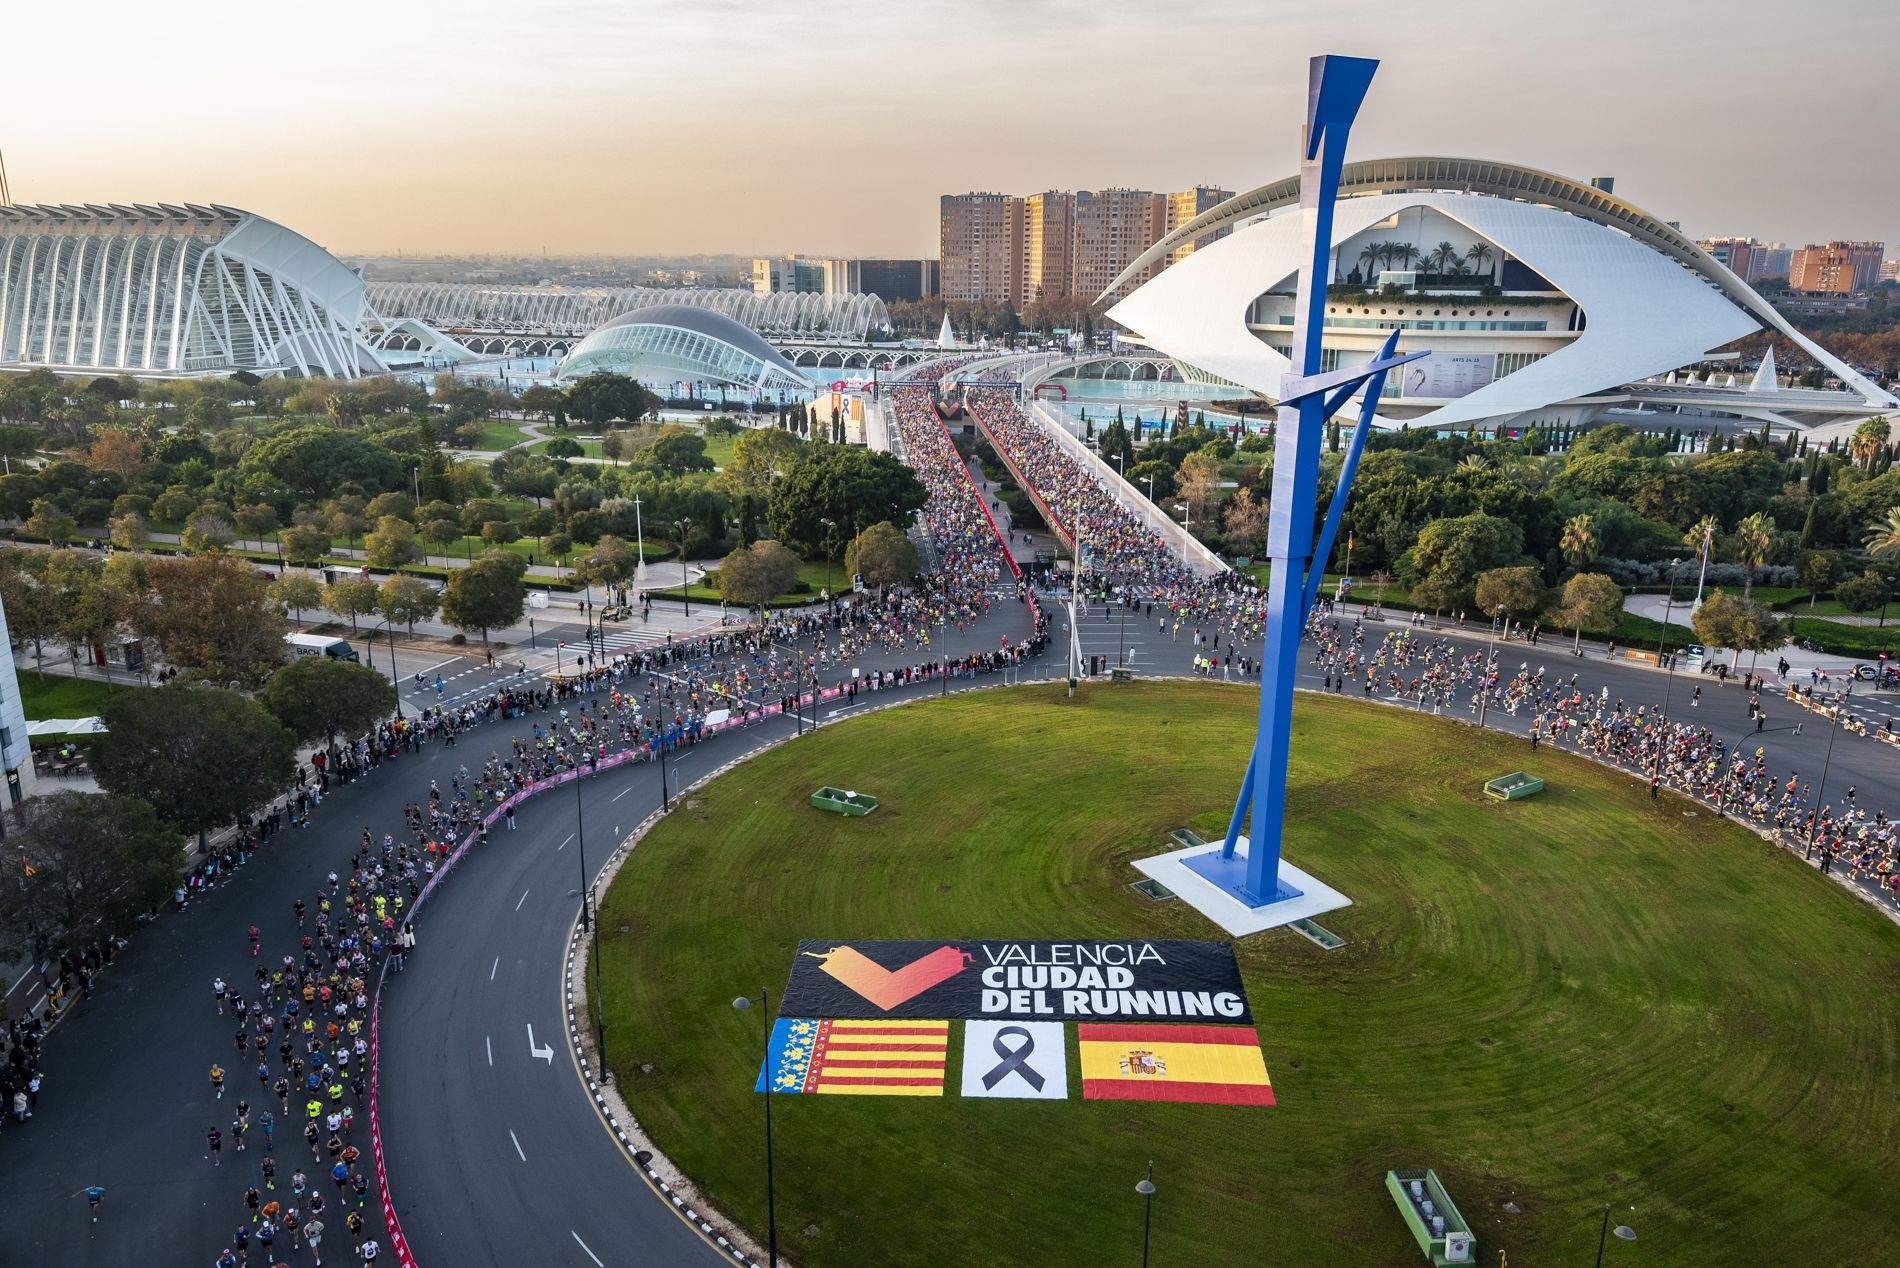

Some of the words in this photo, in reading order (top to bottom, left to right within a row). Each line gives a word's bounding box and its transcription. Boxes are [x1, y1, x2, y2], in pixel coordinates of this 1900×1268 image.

[982, 944, 1166, 966] VALENCIA
[981, 966, 1135, 989] CIUDAD
[981, 989, 1054, 1014] DEL
[1063, 990, 1244, 1018] RUNNING
